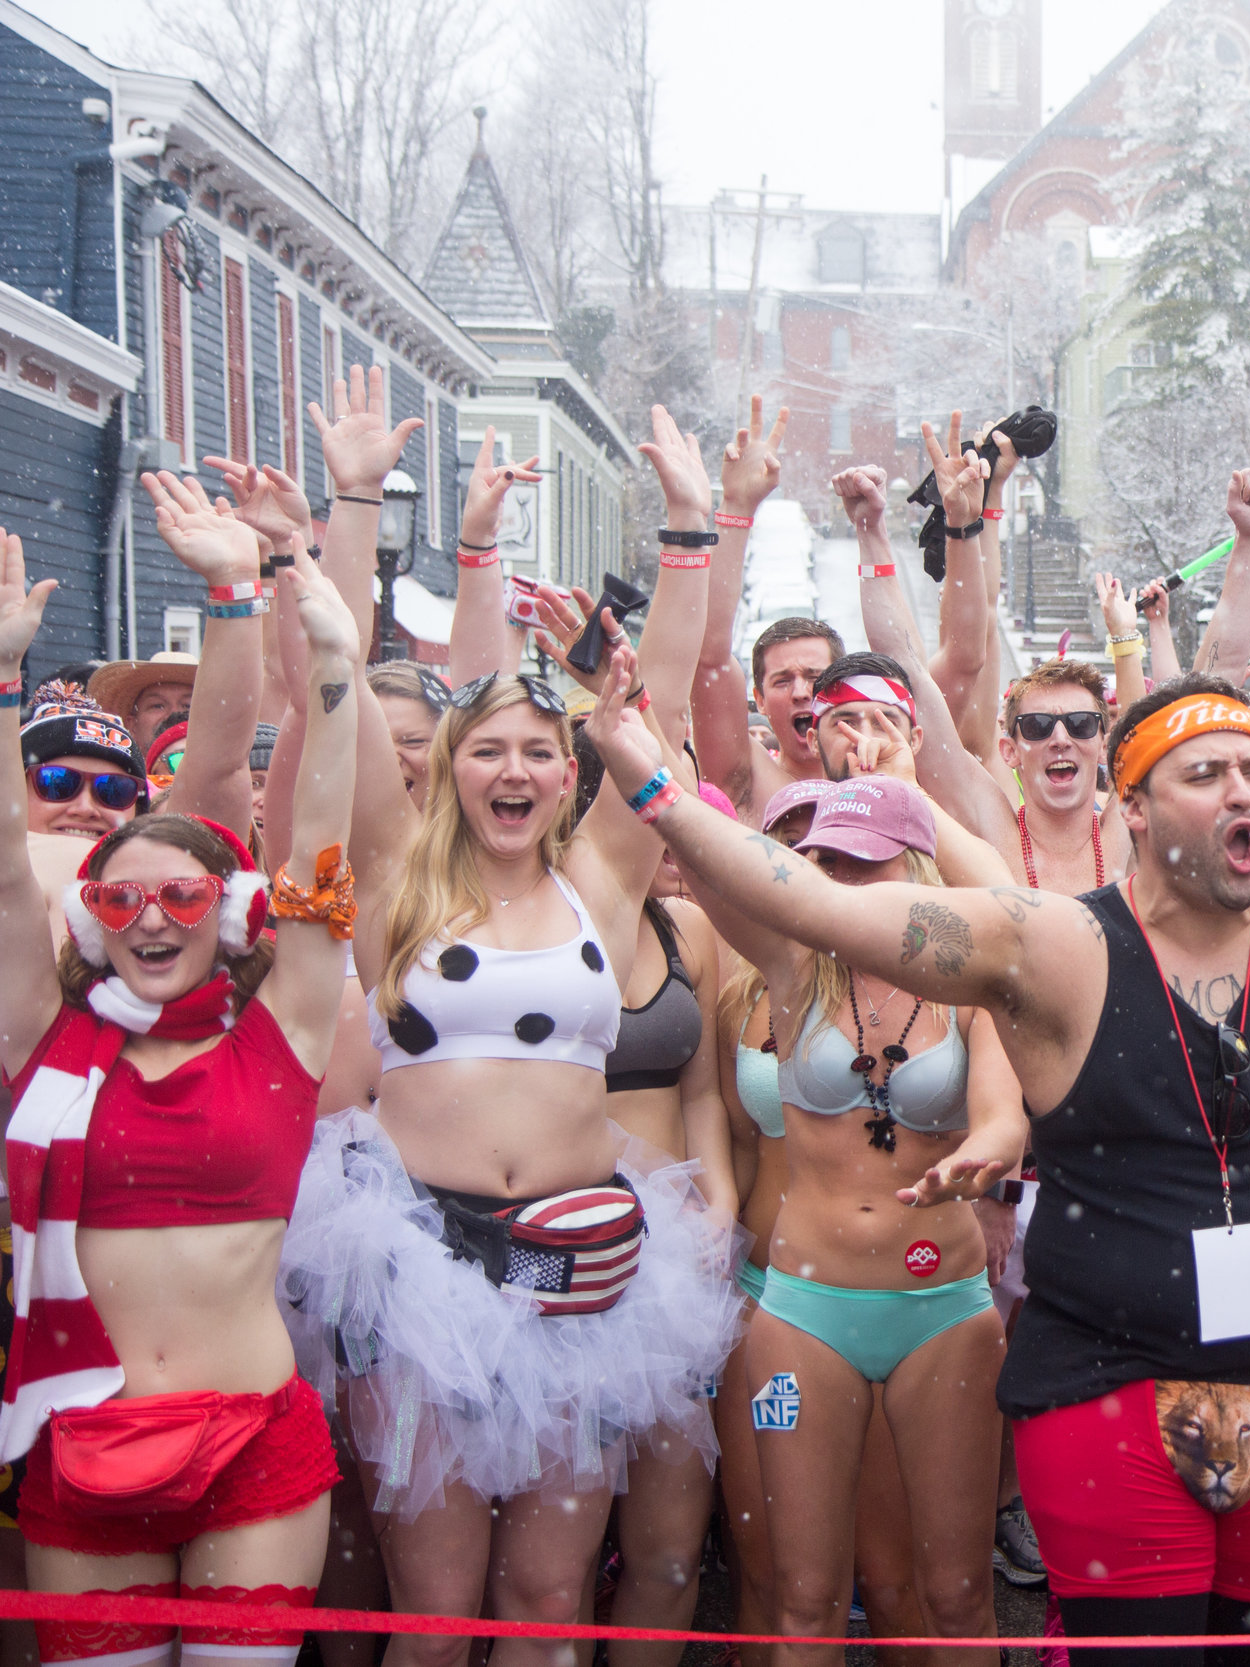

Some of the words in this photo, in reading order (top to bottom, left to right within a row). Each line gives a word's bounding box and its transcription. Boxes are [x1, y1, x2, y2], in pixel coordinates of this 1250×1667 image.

[76, 718, 133, 749] 50
[839, 792, 857, 801] THE
[845, 783, 884, 799] BRING
[820, 800, 872, 817] ALCOHOL
[759, 1399, 800, 1425] NF
